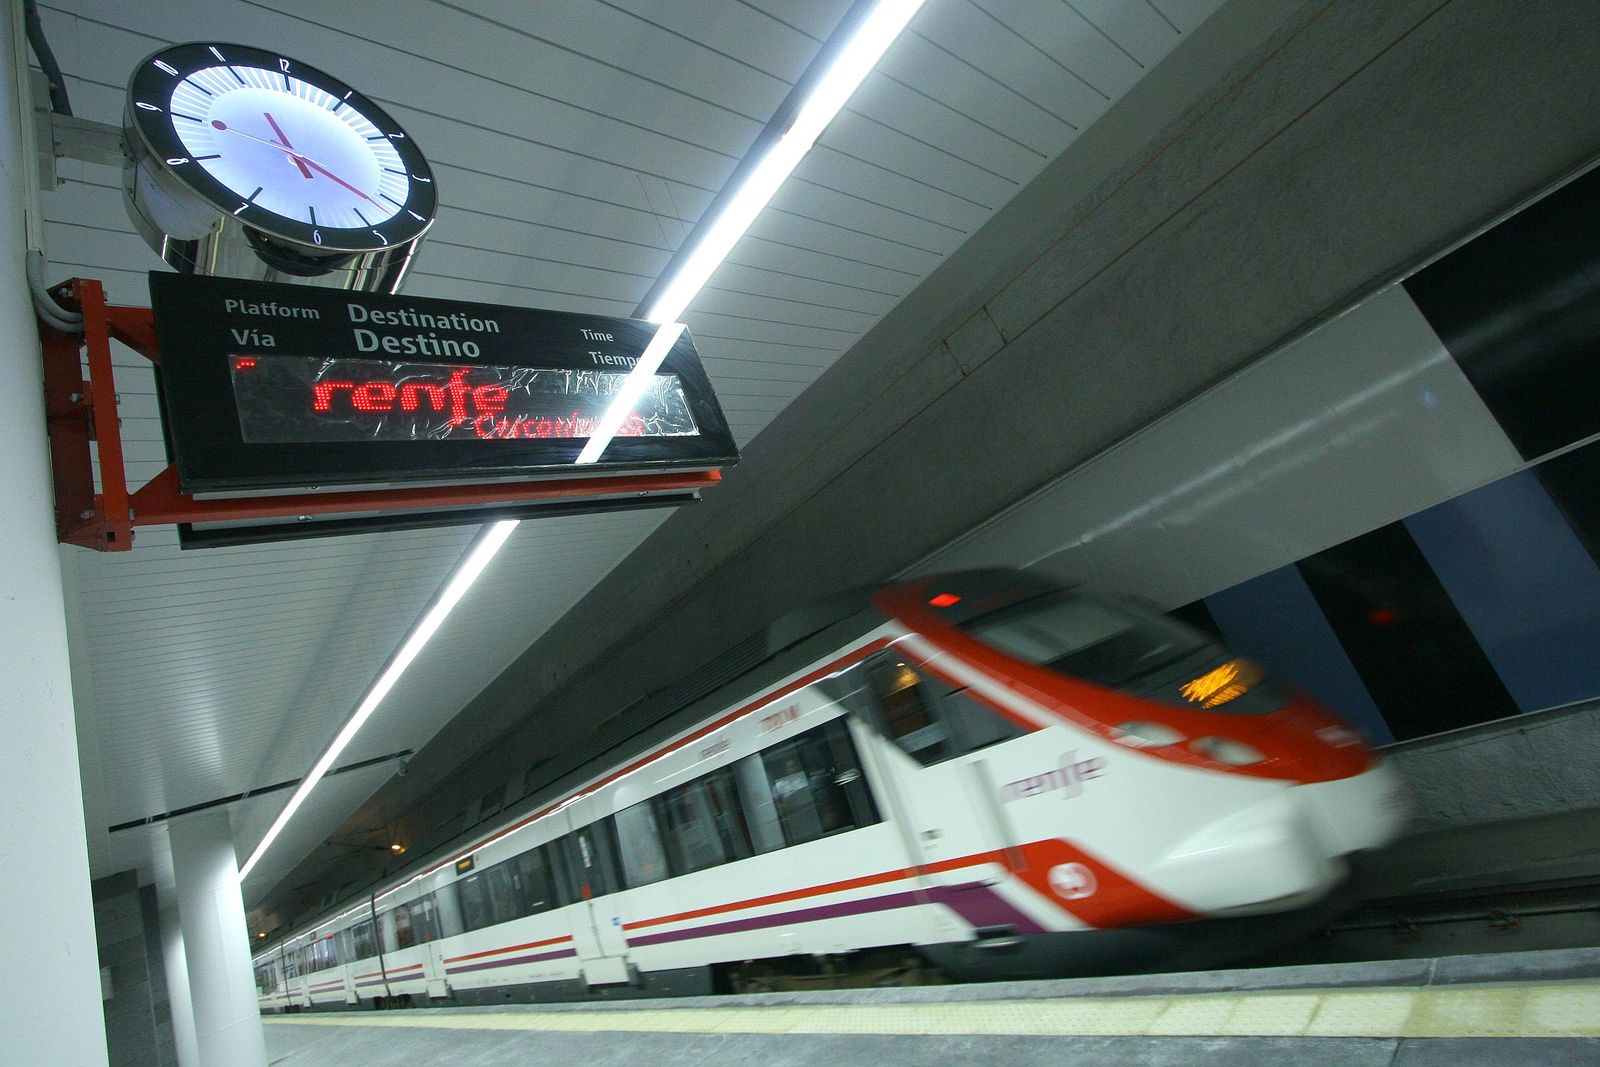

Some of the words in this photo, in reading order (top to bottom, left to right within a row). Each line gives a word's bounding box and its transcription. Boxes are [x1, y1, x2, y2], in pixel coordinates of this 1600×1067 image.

[208, 46, 226, 62] 11
[153, 59, 179, 77] 10
[279, 58, 291, 74] 12
[343, 90, 353, 99] 1
[135, 101, 163, 113] 9
[388, 132, 405, 142] 2
[166, 157, 189, 166] 8
[412, 173, 431, 183] 3
[233, 202, 249, 215] 7
[407, 209, 426, 222] 4
[313, 229, 322, 245] 6
[373, 230, 388, 246] 5
[224, 299, 320, 320] Platform
[347, 303, 500, 333] Destination
[231, 328, 276, 347] Vía
[353, 328, 480, 358] Destino
[580, 328, 614, 342] Time
[313, 368, 509, 427] renfe
